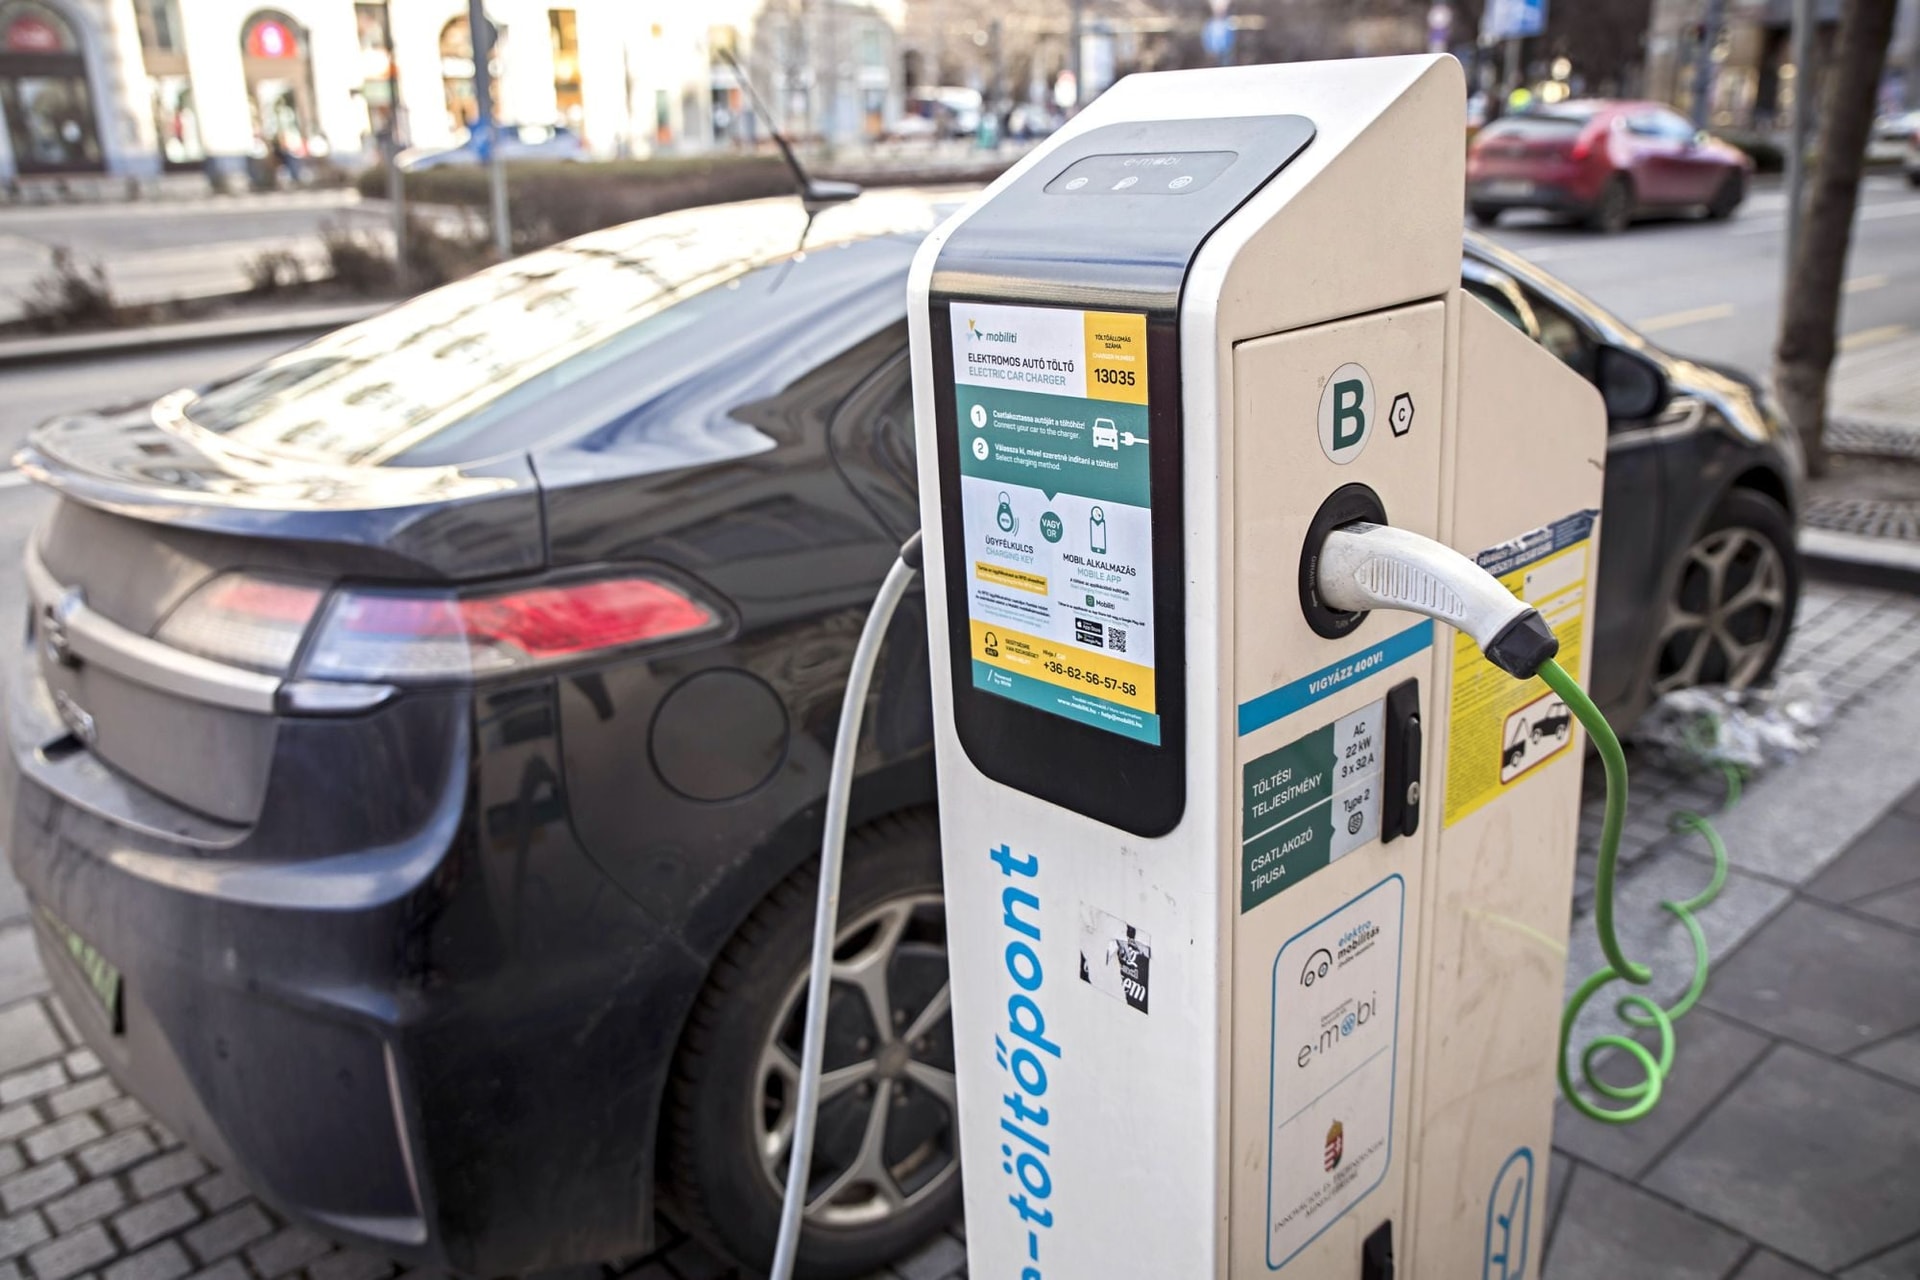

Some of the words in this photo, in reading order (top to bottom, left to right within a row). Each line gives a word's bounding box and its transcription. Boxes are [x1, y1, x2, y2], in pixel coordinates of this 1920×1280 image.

[986, 331, 1018, 343] mobiliti
[968, 352, 1020, 367] ELEKTROMOS
[1022, 357, 1045, 370] AUTÓ
[1046, 359, 1074, 372] TÖLTŐ
[969, 366, 1006, 380] ELECTRIC
[1007, 370, 1023, 381] CAR
[1026, 372, 1066, 386] CHARGER
[1094, 368, 1136, 386] 13035
[1333, 378, 1366, 451] B
[1398, 407, 1405, 422] C
[993, 420, 1016, 430] Connect
[995, 453, 1012, 462] Select
[1014, 457, 1037, 468] charging
[1042, 518, 1060, 529] VAGY
[1047, 529, 1056, 538] OR
[985, 536, 1034, 553] ÜGYFÉLKULCS
[986, 547, 1020, 561] CHARGING
[1020, 554, 1034, 565] KEY
[1063, 553, 1085, 565] MOBIL
[1086, 559, 1136, 576] ALKALMAZÁS
[1078, 567, 1104, 581] MOBILE
[1106, 575, 1121, 584] APP
[1096, 600, 1115, 610] Mobiliti
[1044, 661, 1136, 696] +36-62-56-57-58
[1309, 665, 1353, 694] VIGYÁZZ
[1354, 650, 1383, 672] 400V!
[1353, 722, 1366, 738] AC
[1346, 743, 1358, 759] 22
[1358, 735, 1372, 752] kW
[1341, 765, 1348, 778] 3
[1349, 765, 1354, 775] x
[1356, 756, 1367, 771] 32
[1368, 752, 1374, 764] A
[1252, 767, 1292, 797] TÖLTÉSI
[1252, 772, 1322, 818] TELJESÍTMÉNY
[1344, 794, 1362, 813] Type
[1364, 788, 1370, 801] 2
[1251, 826, 1313, 872] CSATLAKOZÓ
[1250, 864, 1286, 892] TÍPUSA
[1337, 926, 1380, 960] mobilitás
[1338, 920, 1371, 947] elektro
